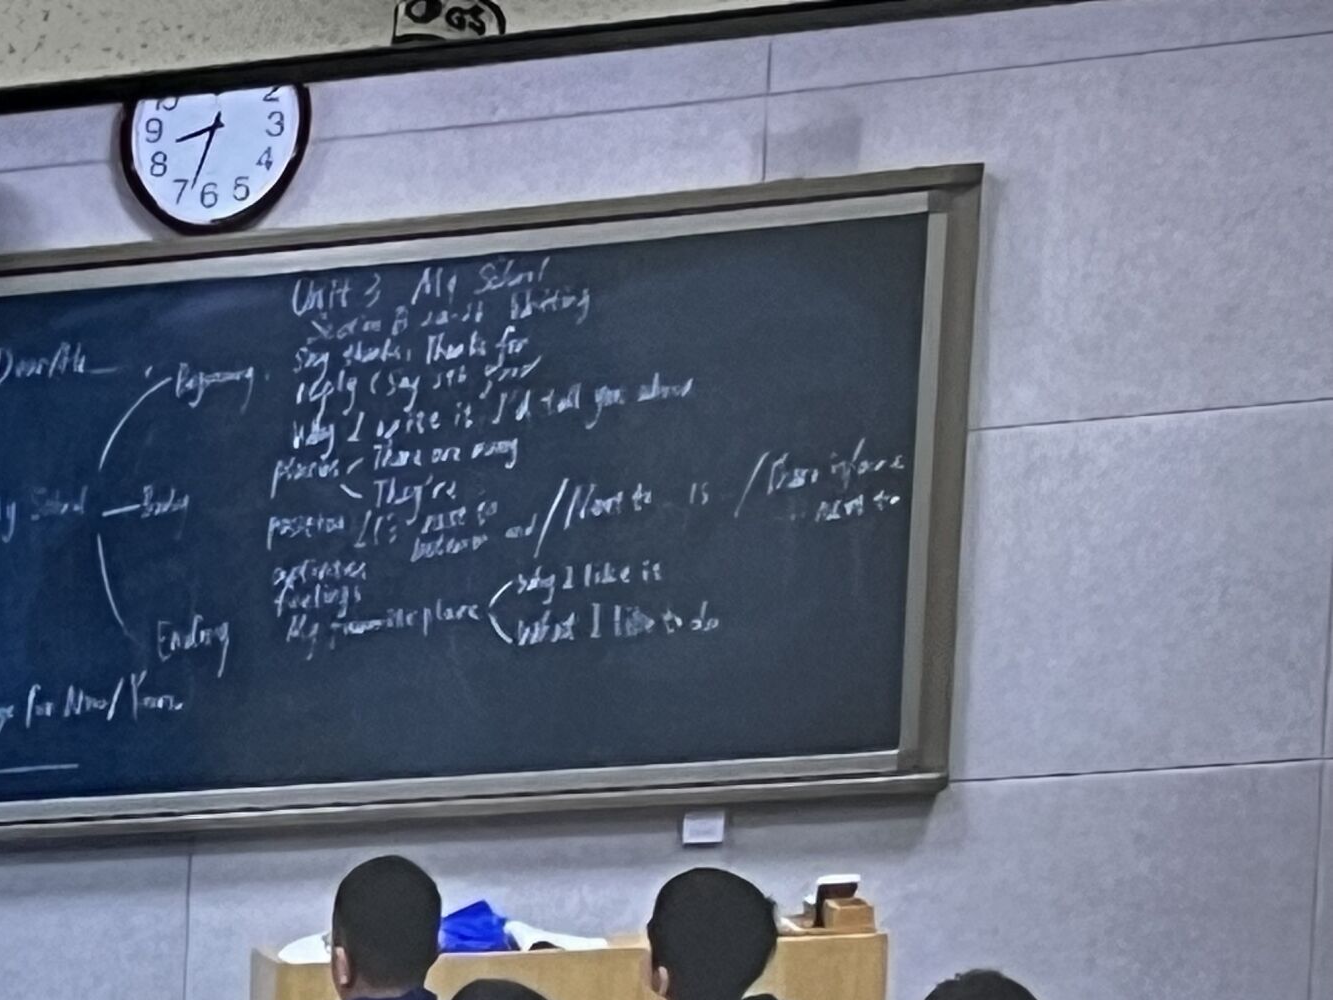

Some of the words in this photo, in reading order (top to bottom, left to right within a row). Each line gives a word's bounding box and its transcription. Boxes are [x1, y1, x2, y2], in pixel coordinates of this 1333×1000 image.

[145, 117, 163, 143] 9
[266, 111, 285, 137] 3
[149, 151, 168, 177] 8
[255, 146, 274, 171] 4
[173, 179, 189, 204] 7
[200, 182, 218, 208] 6
[233, 176, 250, 201] 5
[292, 279, 352, 317] Unit
[363, 272, 383, 308] 3
[583, 561, 632, 588] like
